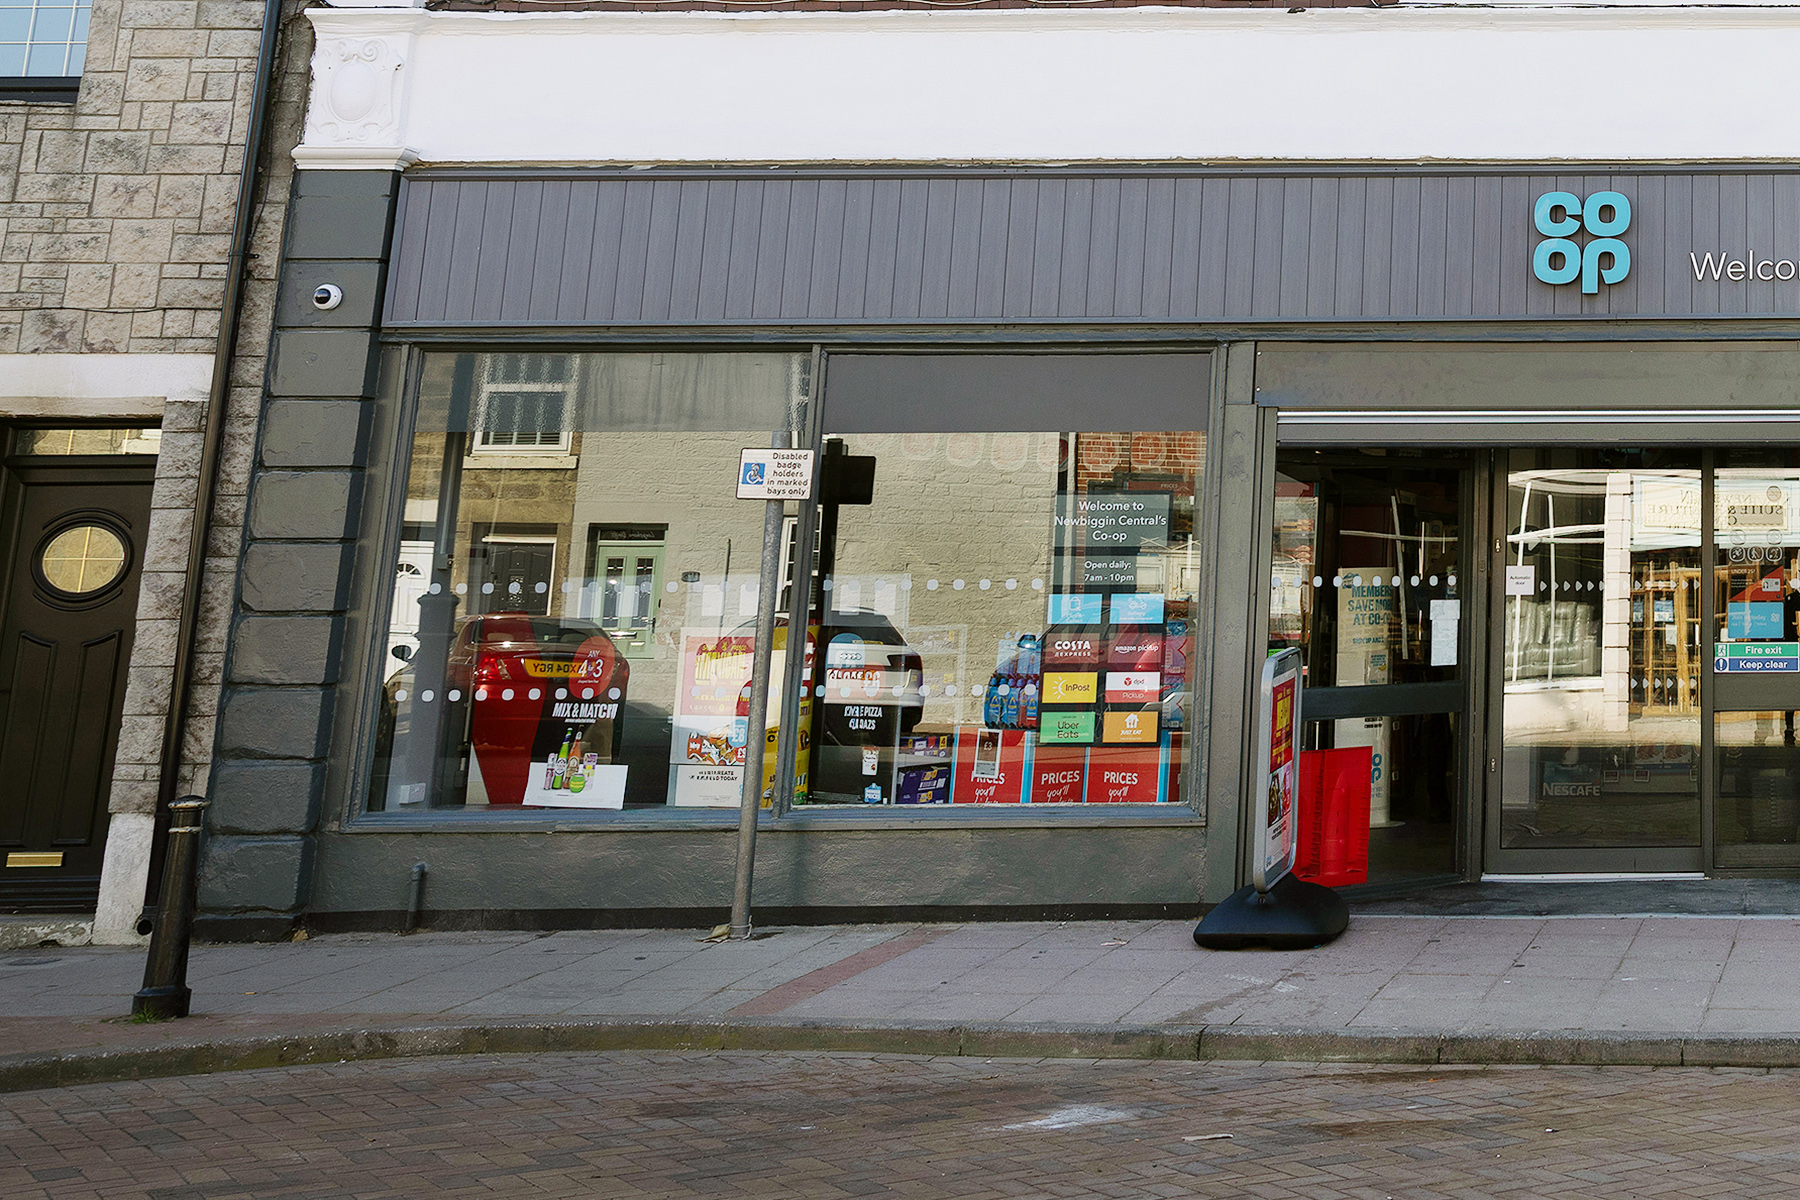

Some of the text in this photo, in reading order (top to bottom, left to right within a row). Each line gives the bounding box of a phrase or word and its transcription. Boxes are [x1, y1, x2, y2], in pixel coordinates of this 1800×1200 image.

[772, 452, 809, 460] Disabled
[776, 461, 802, 469] badge
[767, 487, 807, 496] bays only
[1078, 500, 1144, 511] Welcome to
[1054, 515, 1167, 529] Newbiggin Central's
[1092, 530, 1127, 543] Co-op
[1084, 560, 1131, 571] Open daily:
[1109, 574, 1135, 583] 10pm
[1347, 599, 1374, 612] SAVE
[1352, 613, 1367, 626] AT
[1054, 641, 1091, 650] COSTA
[1115, 645, 1159, 654] amazon pickup
[1745, 646, 1782, 654] Fire exit
[578, 659, 588, 677] 4
[593, 658, 604, 678] 3
[1739, 660, 1788, 669] Keep clear
[1065, 684, 1090, 692] InPost
[1122, 692, 1145, 701] Pickup
[552, 703, 572, 717] MIX
[571, 703, 580, 718] &
[1057, 720, 1080, 730] Uber
[1057, 730, 1080, 739] Eats
[983, 741, 992, 750] £3
[1041, 770, 1080, 785] PRICES
[1103, 771, 1139, 785] PRICES
